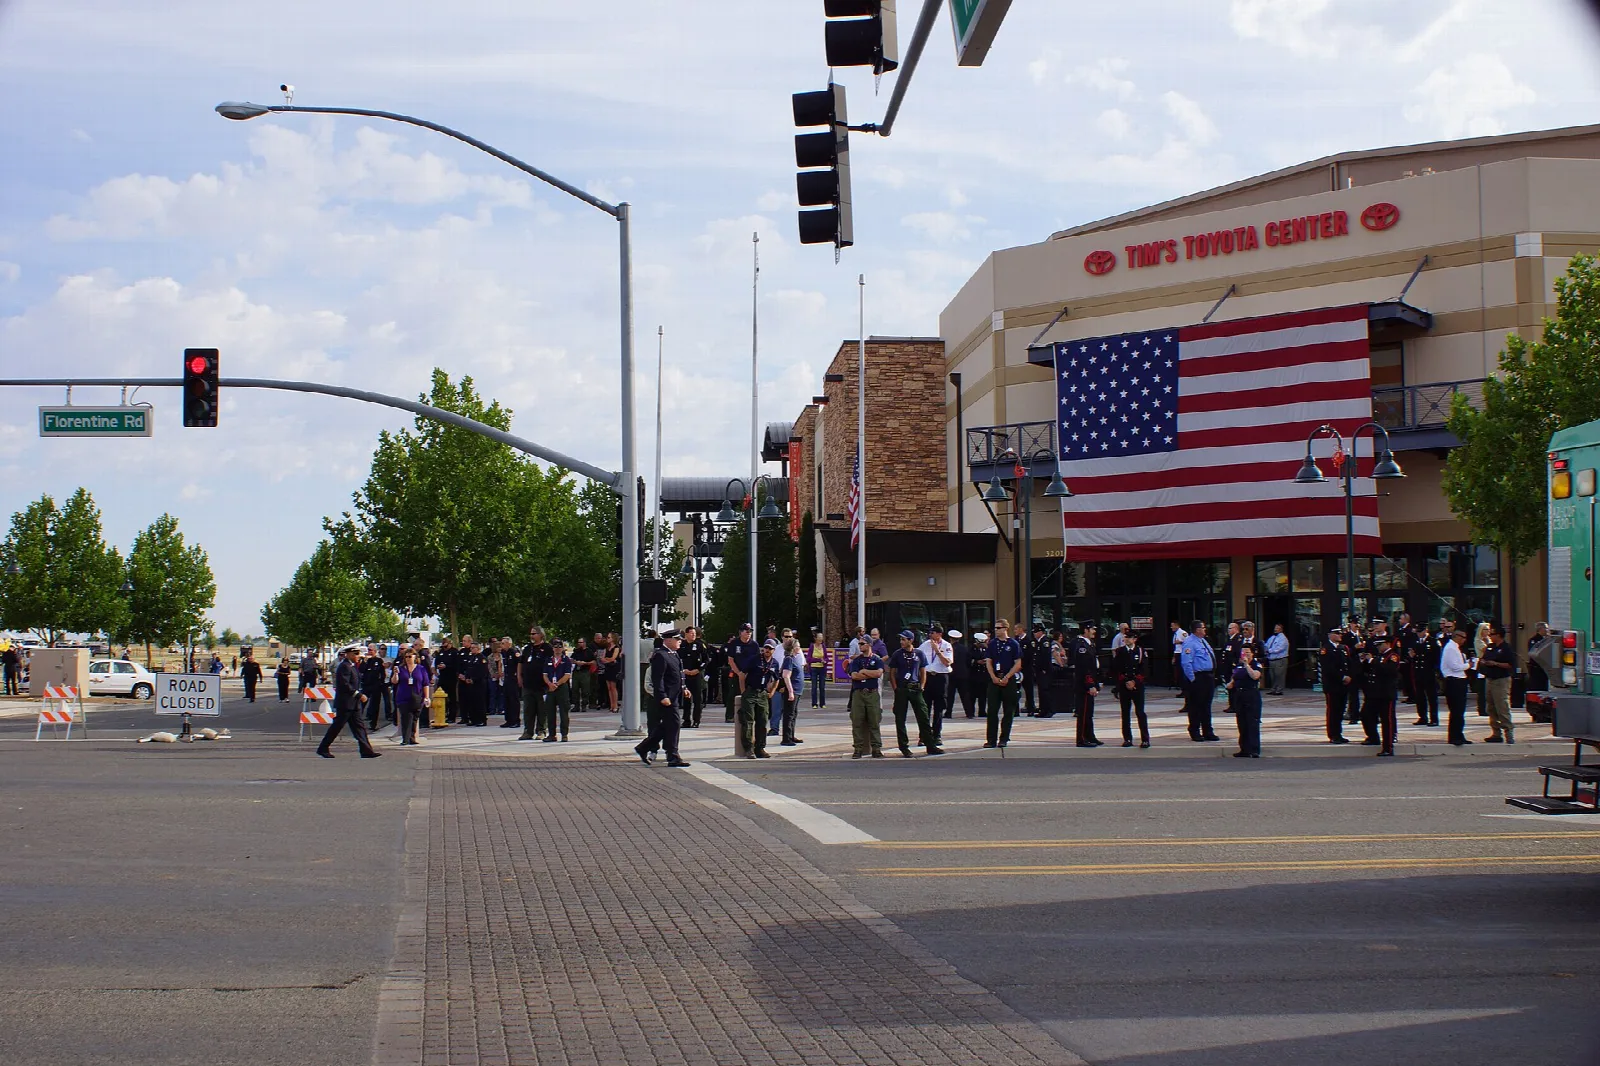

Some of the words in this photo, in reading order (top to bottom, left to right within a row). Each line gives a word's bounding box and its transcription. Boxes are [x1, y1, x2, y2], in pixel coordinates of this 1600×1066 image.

[1125, 239, 1178, 268] TIM'S
[1182, 225, 1258, 260] TOYOTA
[1264, 210, 1348, 247] CENTER
[45, 414, 119, 428] Florentine
[124, 414, 144, 428] Rd
[169, 679, 207, 693] ROAD
[160, 696, 215, 710] CLOSED
